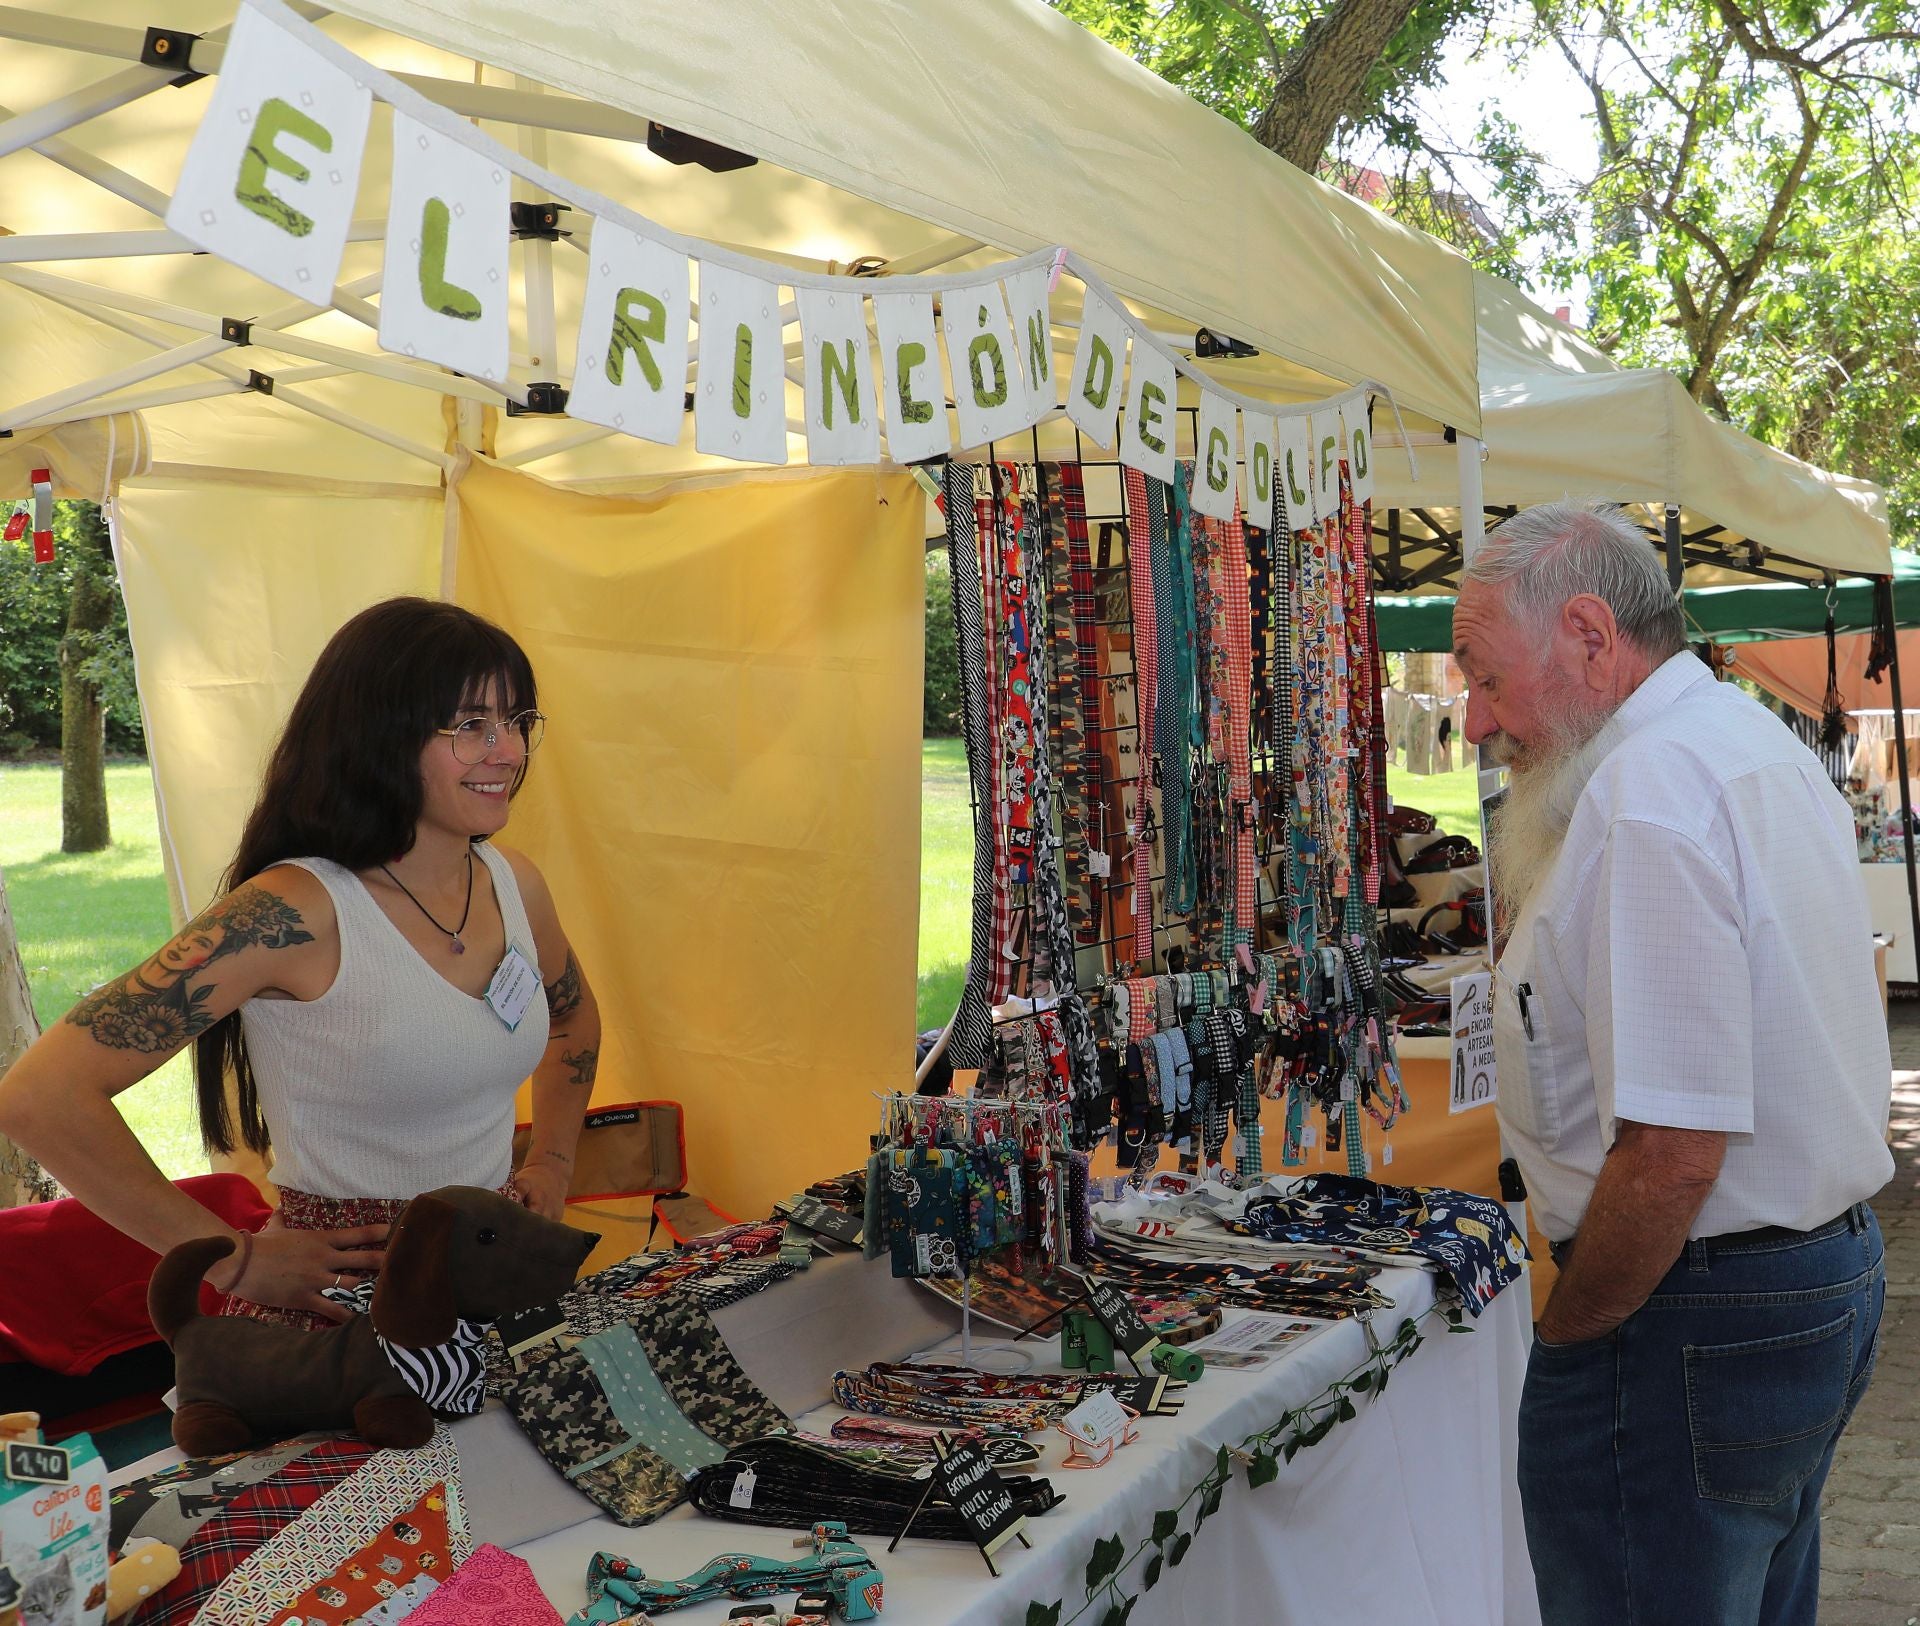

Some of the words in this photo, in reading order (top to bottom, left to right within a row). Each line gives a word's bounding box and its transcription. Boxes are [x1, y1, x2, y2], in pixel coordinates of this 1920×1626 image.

[235, 97, 482, 321] EL
[604, 287, 1048, 431] RINCÓN
[1083, 332, 1168, 454] DE
[1205, 426, 1367, 506] GOLFO
[1473, 1002, 1480, 1016] SE
[1472, 1055, 1477, 1068] A
[1092, 1287, 1113, 1308] PORTA
[946, 1471, 974, 1497] EXTRA
[969, 1454, 996, 1483] LARGA
[33, 1485, 81, 1517] Calibra
[51, 1511, 75, 1541] Life
